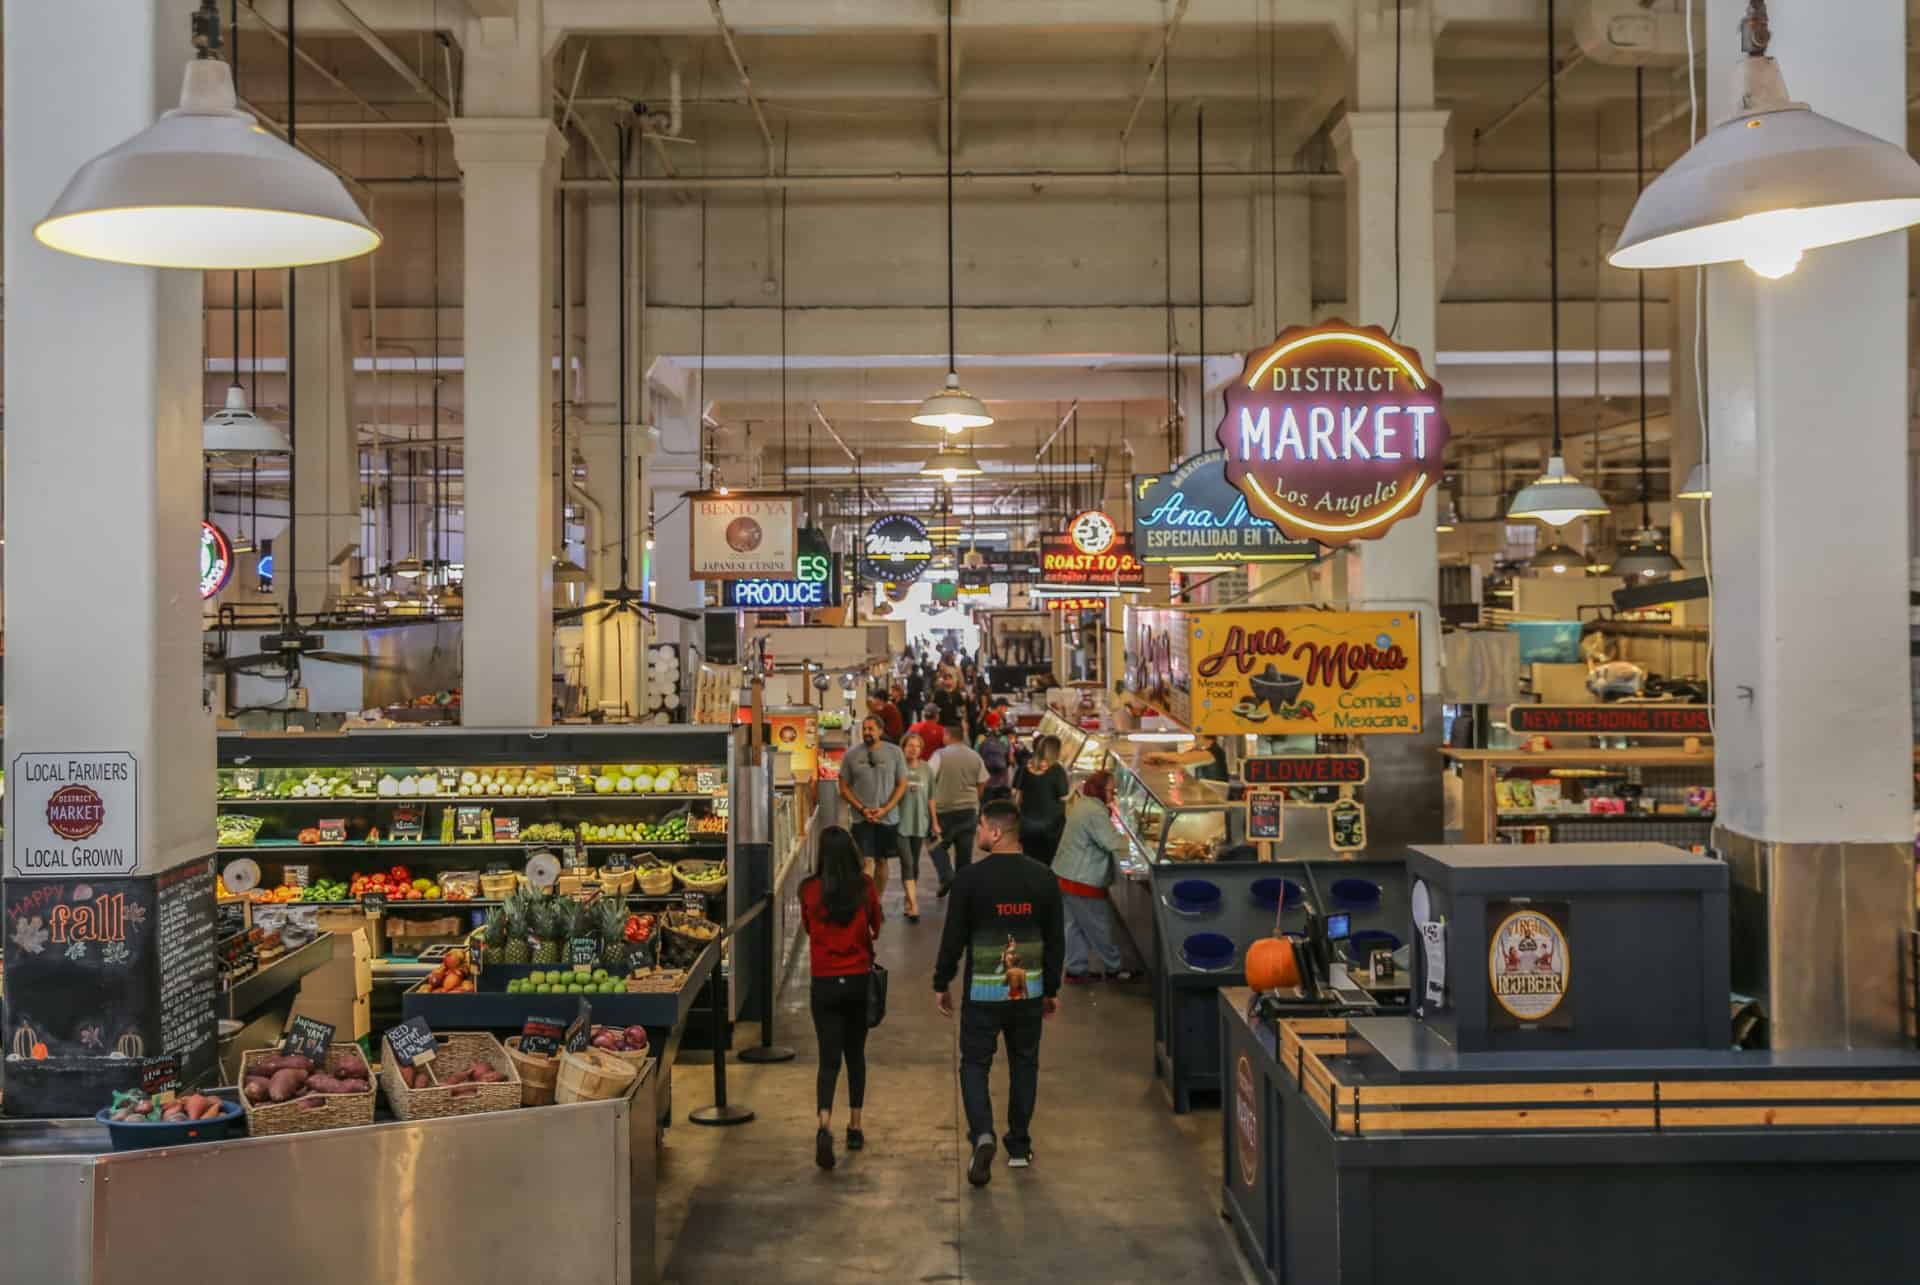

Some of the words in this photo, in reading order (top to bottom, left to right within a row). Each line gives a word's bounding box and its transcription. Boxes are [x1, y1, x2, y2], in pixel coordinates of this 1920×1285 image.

[1272, 367, 1399, 391] DISTRICT
[1239, 406, 1435, 460] MARKET
[1275, 477, 1308, 508] Los
[1315, 480, 1399, 517] Angeles
[701, 503, 760, 515] BENTO
[1138, 492, 1212, 526] Ana
[1147, 530, 1237, 547] ESPECIALIDAD
[1244, 530, 1262, 546] EN
[1044, 555, 1094, 570] ROAST
[1098, 555, 1117, 570] TO
[1121, 556, 1142, 570] G
[735, 581, 822, 605] PRODUCE
[1198, 626, 1291, 677] Ana
[1293, 641, 1409, 690] Maria
[1338, 692, 1402, 709] Comida
[1334, 712, 1409, 728] Mexicana
[1521, 711, 1561, 729] NEW
[1566, 711, 1649, 729] TRENDING
[1653, 711, 1708, 729] ITEMS
[25, 761, 65, 782] LOCAL
[68, 760, 128, 780] FARMERS
[1250, 760, 1360, 780] FLOWERS
[50, 805, 101, 820] MARKET
[25, 847, 68, 868] LOCAL
[72, 846, 123, 867] GROWN
[8, 885, 65, 918] HAPPY
[995, 903, 1033, 916] TOUR
[50, 893, 125, 943] fall
